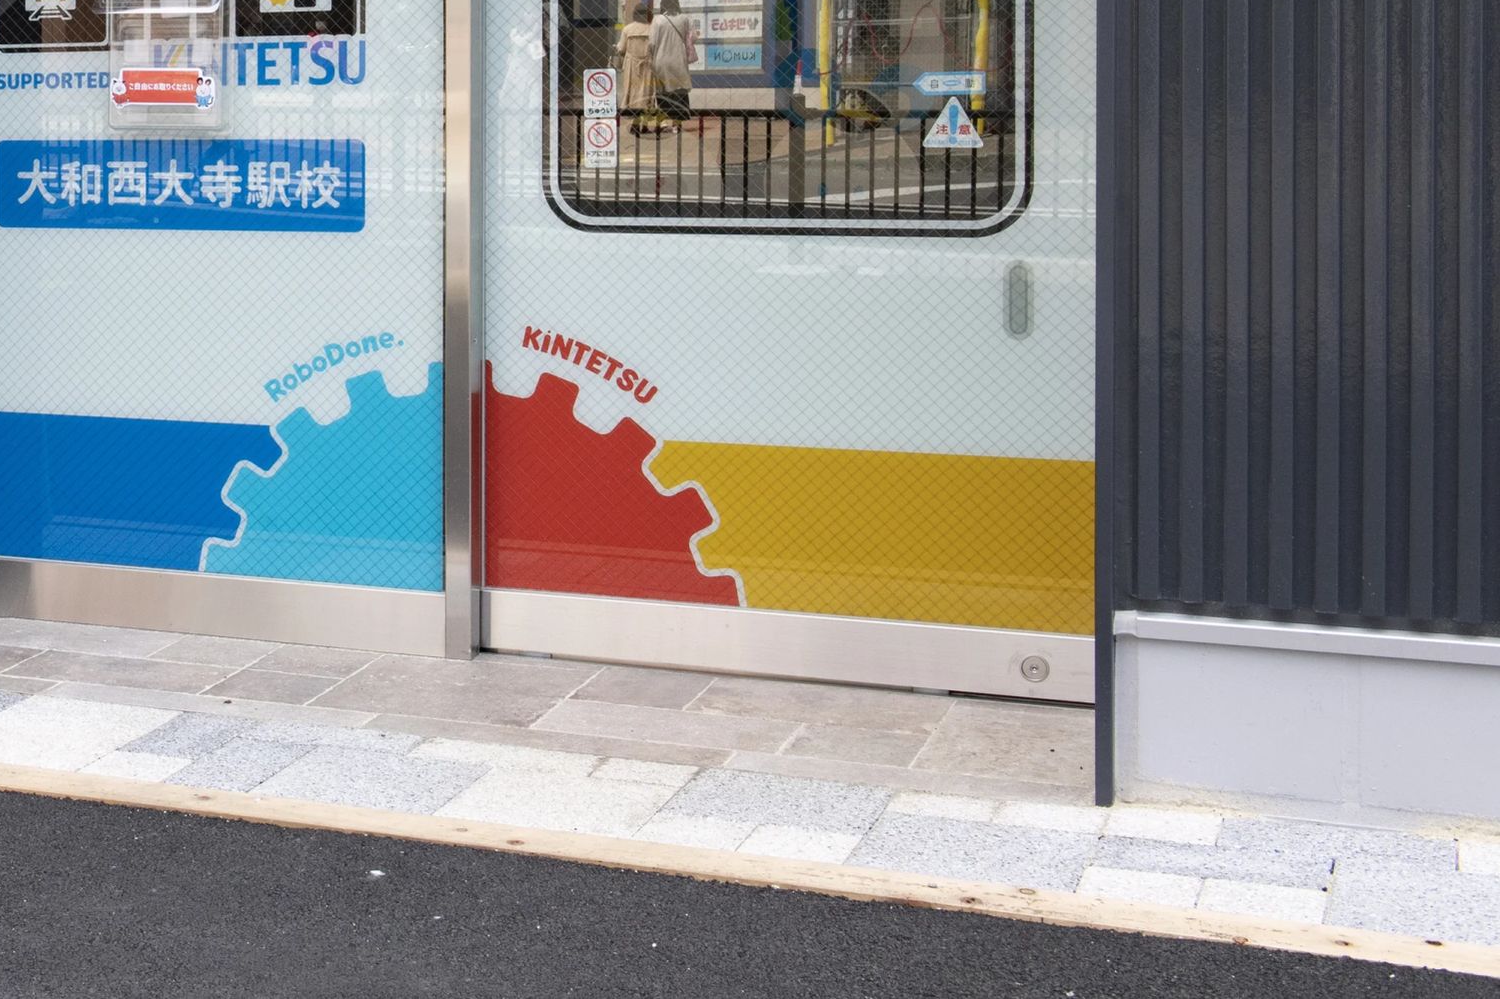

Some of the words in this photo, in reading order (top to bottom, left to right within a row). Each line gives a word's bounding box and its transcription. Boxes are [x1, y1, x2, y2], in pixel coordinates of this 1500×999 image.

[17, 158, 341, 209] 大和西大寺駅校
